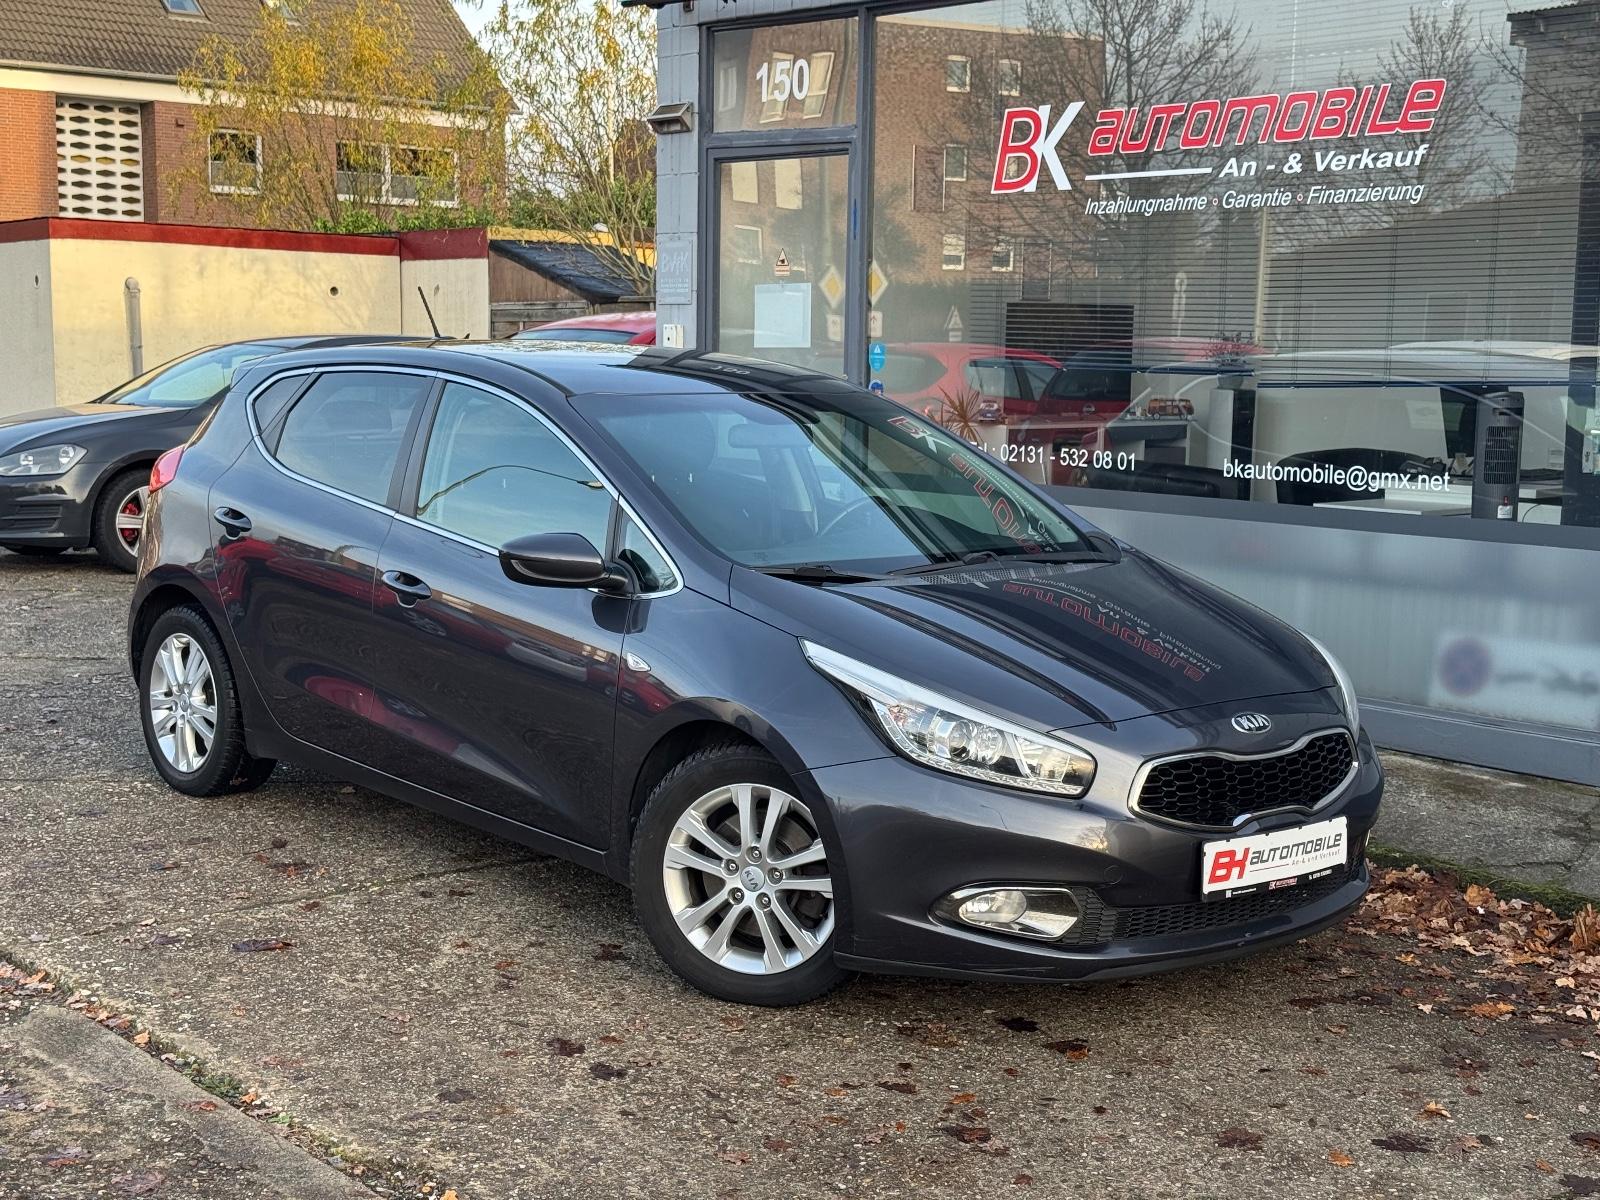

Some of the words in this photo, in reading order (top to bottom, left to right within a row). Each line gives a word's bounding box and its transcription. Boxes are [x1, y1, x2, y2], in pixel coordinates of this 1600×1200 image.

[756, 59, 810, 103] 150
[991, 101, 1086, 194] BK
[1219, 157, 1257, 177] An
[1282, 152, 1303, 174] &
[1314, 143, 1430, 172] Verkauf
[1085, 194, 1208, 217] Inzahlungnahme
[1222, 188, 1292, 208] Garantie
[1306, 183, 1425, 205] Finanzierung
[1000, 444, 1044, 464] 02131
[1060, 448, 1088, 467] 532
[1092, 450, 1113, 469] 08
[1117, 452, 1135, 471] 01
[1223, 458, 1450, 492] bkautomobile@gmx.net
[1235, 713, 1270, 731] KIA
[745, 870, 759, 890] KIA
